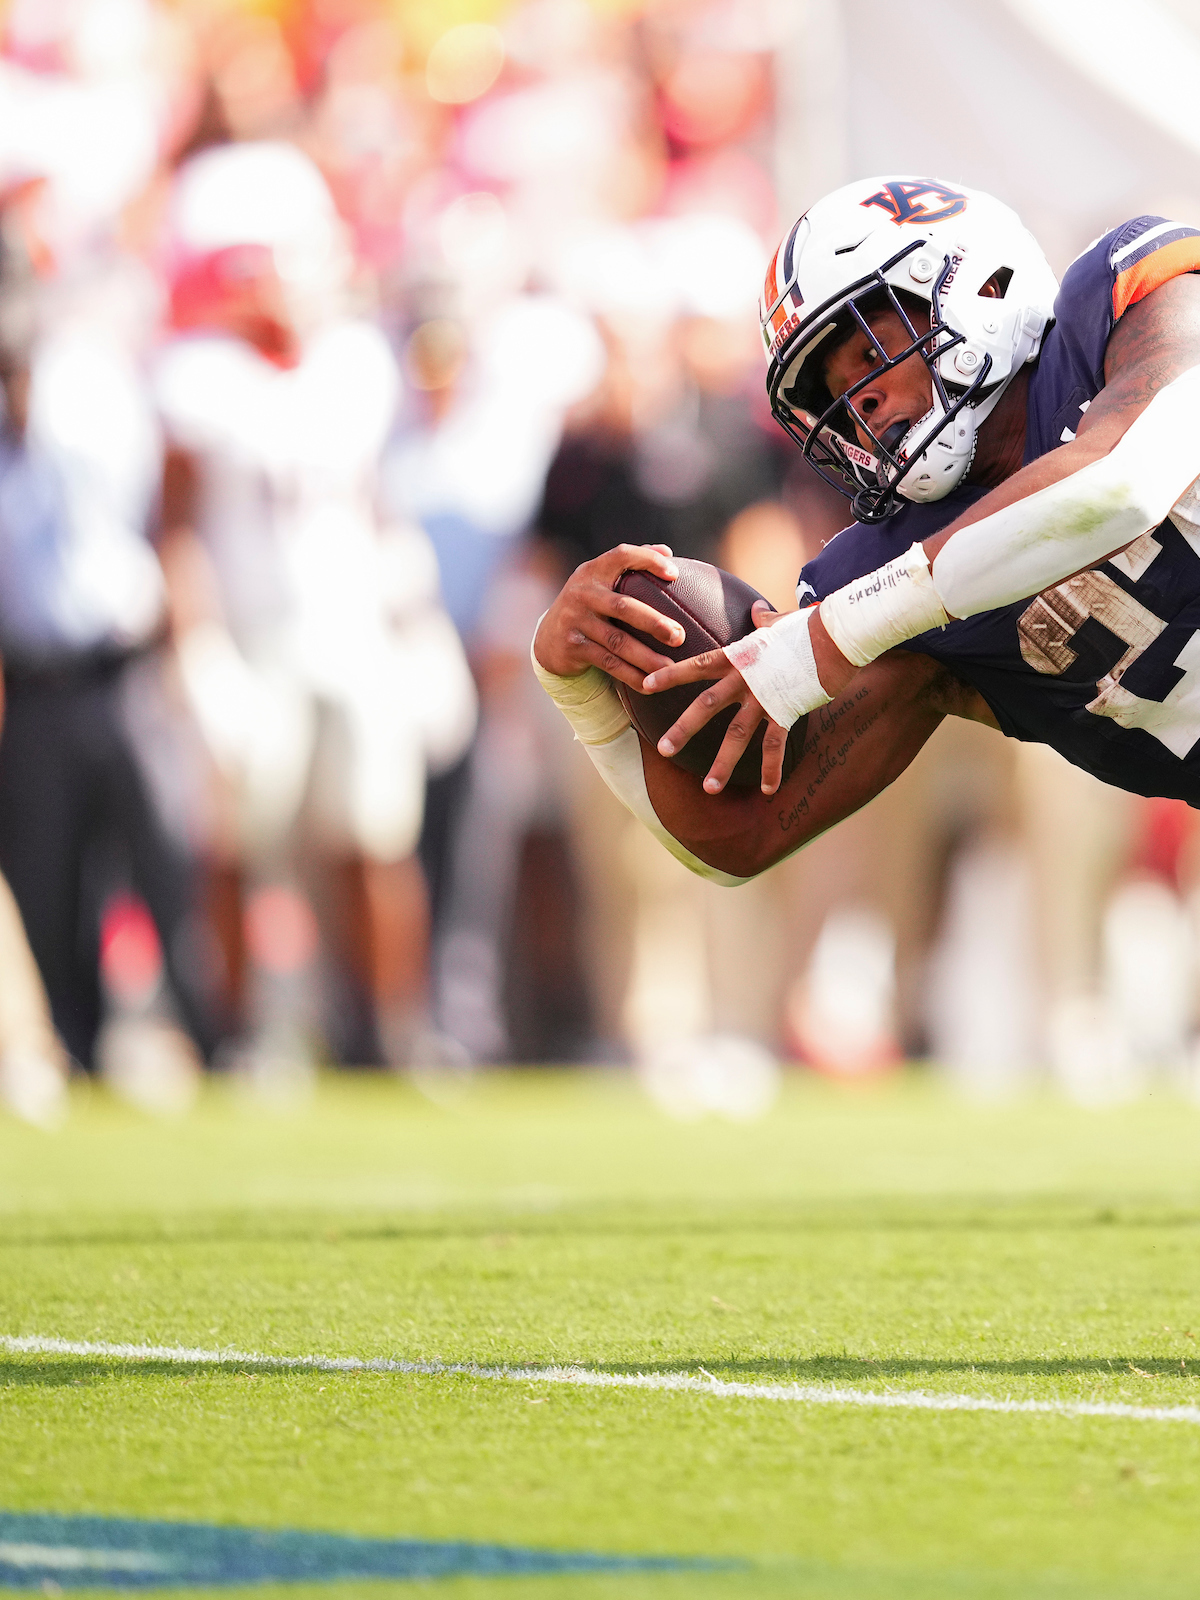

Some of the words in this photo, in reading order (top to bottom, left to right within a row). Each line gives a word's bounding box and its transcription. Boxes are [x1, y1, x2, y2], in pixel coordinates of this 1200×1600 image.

[819, 702, 855, 734] defeats
[778, 796, 810, 831] Enjoy
[815, 745, 838, 785] while
[837, 740, 854, 766] you
[854, 715, 878, 738] have
